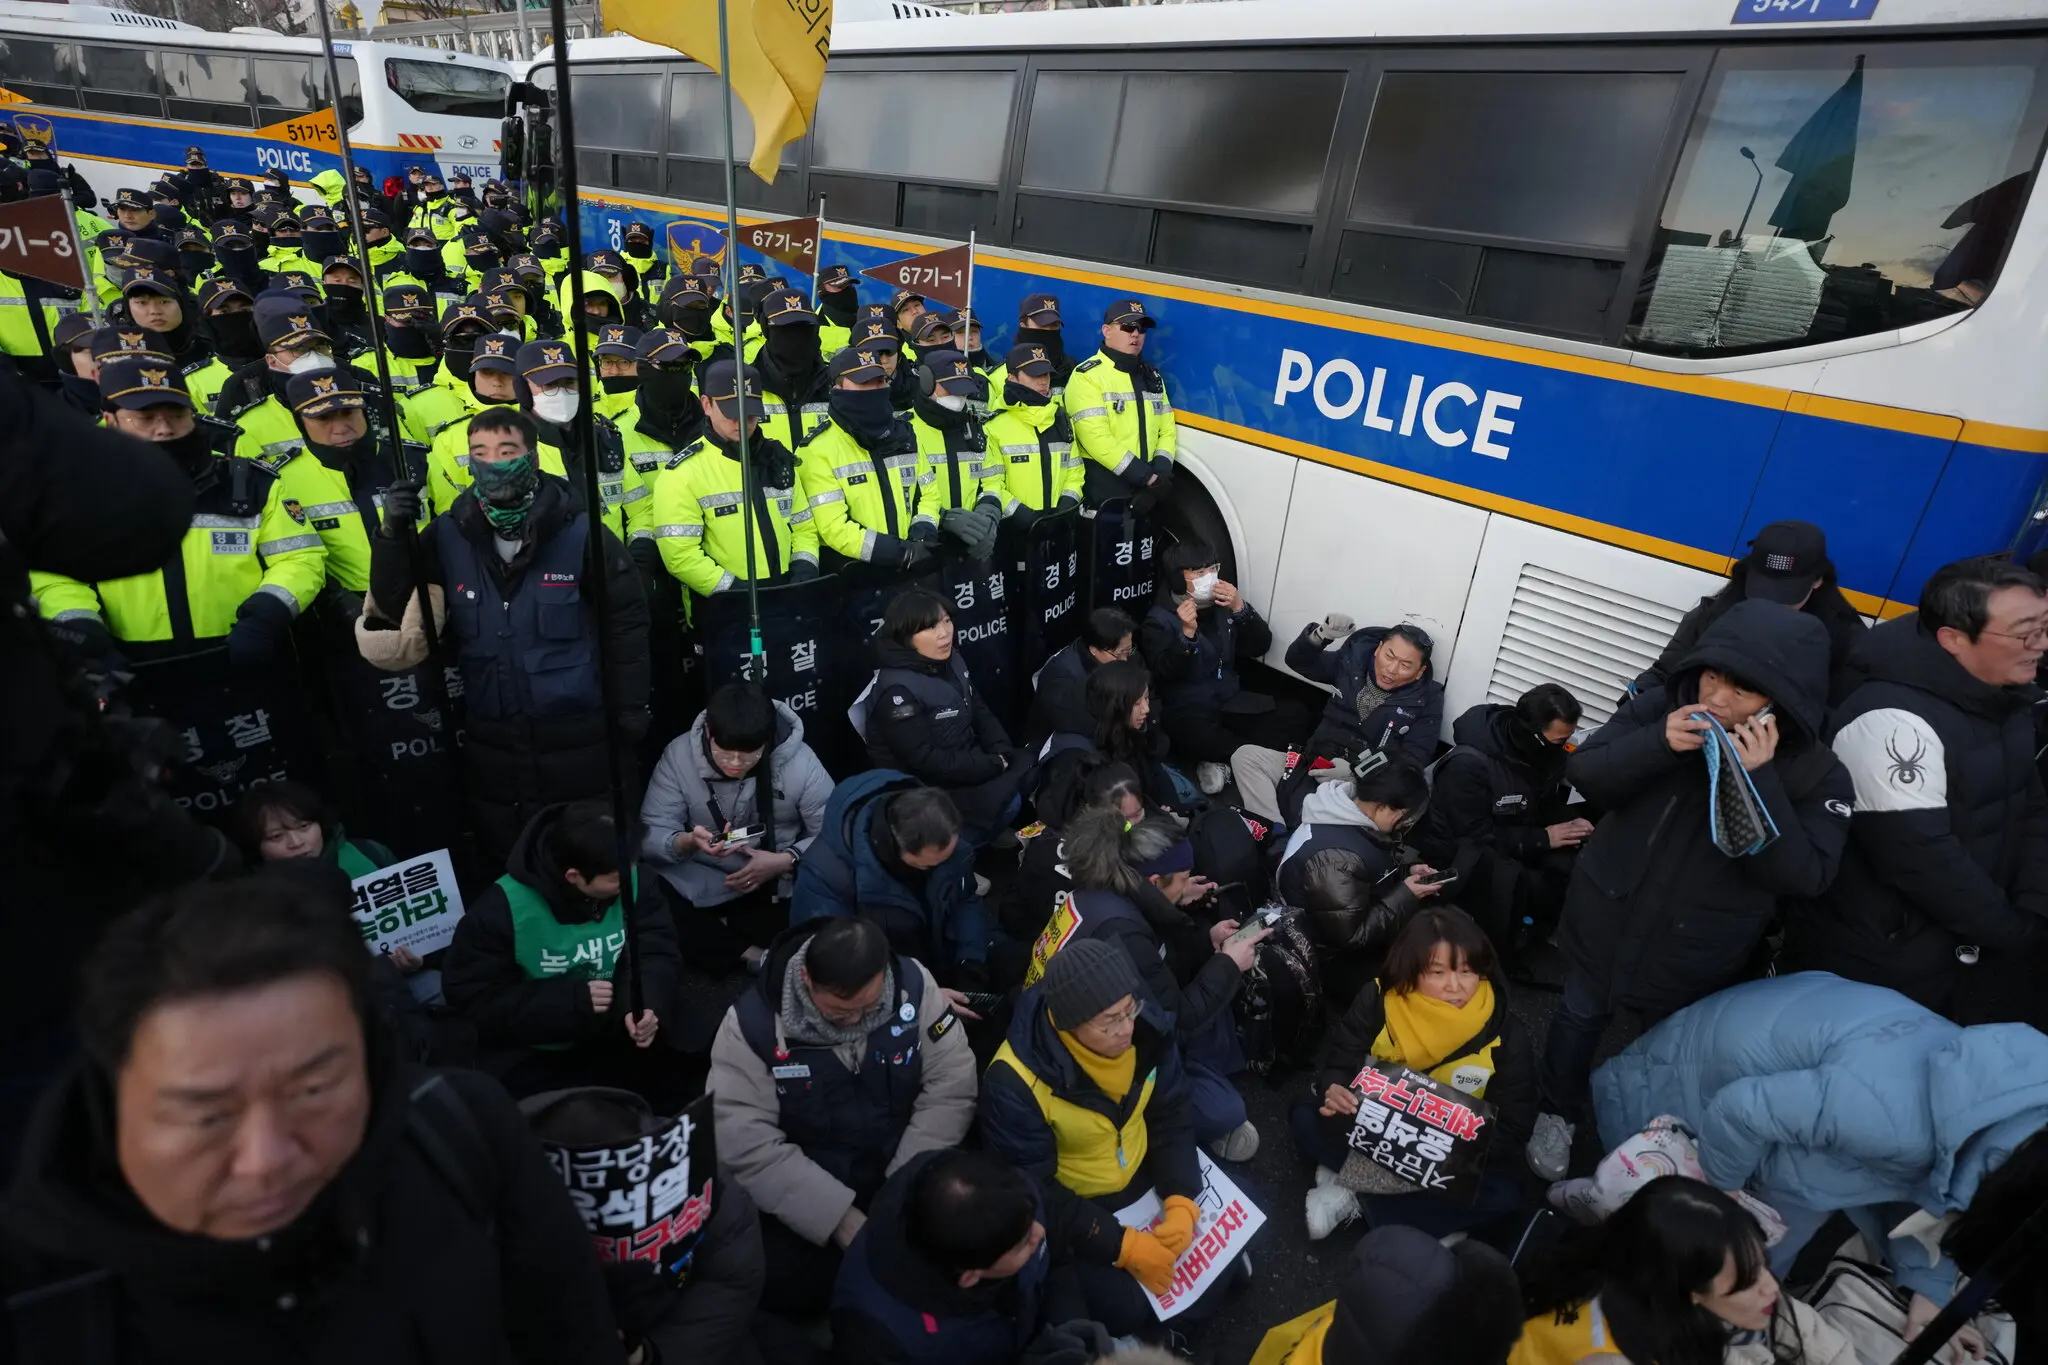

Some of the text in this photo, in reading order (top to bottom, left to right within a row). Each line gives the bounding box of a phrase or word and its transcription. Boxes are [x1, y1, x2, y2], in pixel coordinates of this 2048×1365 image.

[287, 123, 337, 142] 51기-3
[256, 147, 313, 173] POLICE
[452, 165, 491, 178] POLICE
[607, 218, 621, 251] 경
[752, 230, 814, 255] 67기-2
[899, 266, 963, 288] 67기-1
[1273, 348, 1523, 461] POLICE
[215, 545, 248, 553] POLICE
[1112, 580, 1153, 602] POLICE
[1044, 591, 1077, 624] POLICE
[956, 615, 1008, 646] POLICE
[1355, 1097, 1455, 1162] 윤석열
[568, 1156, 691, 1233] 윤석열
